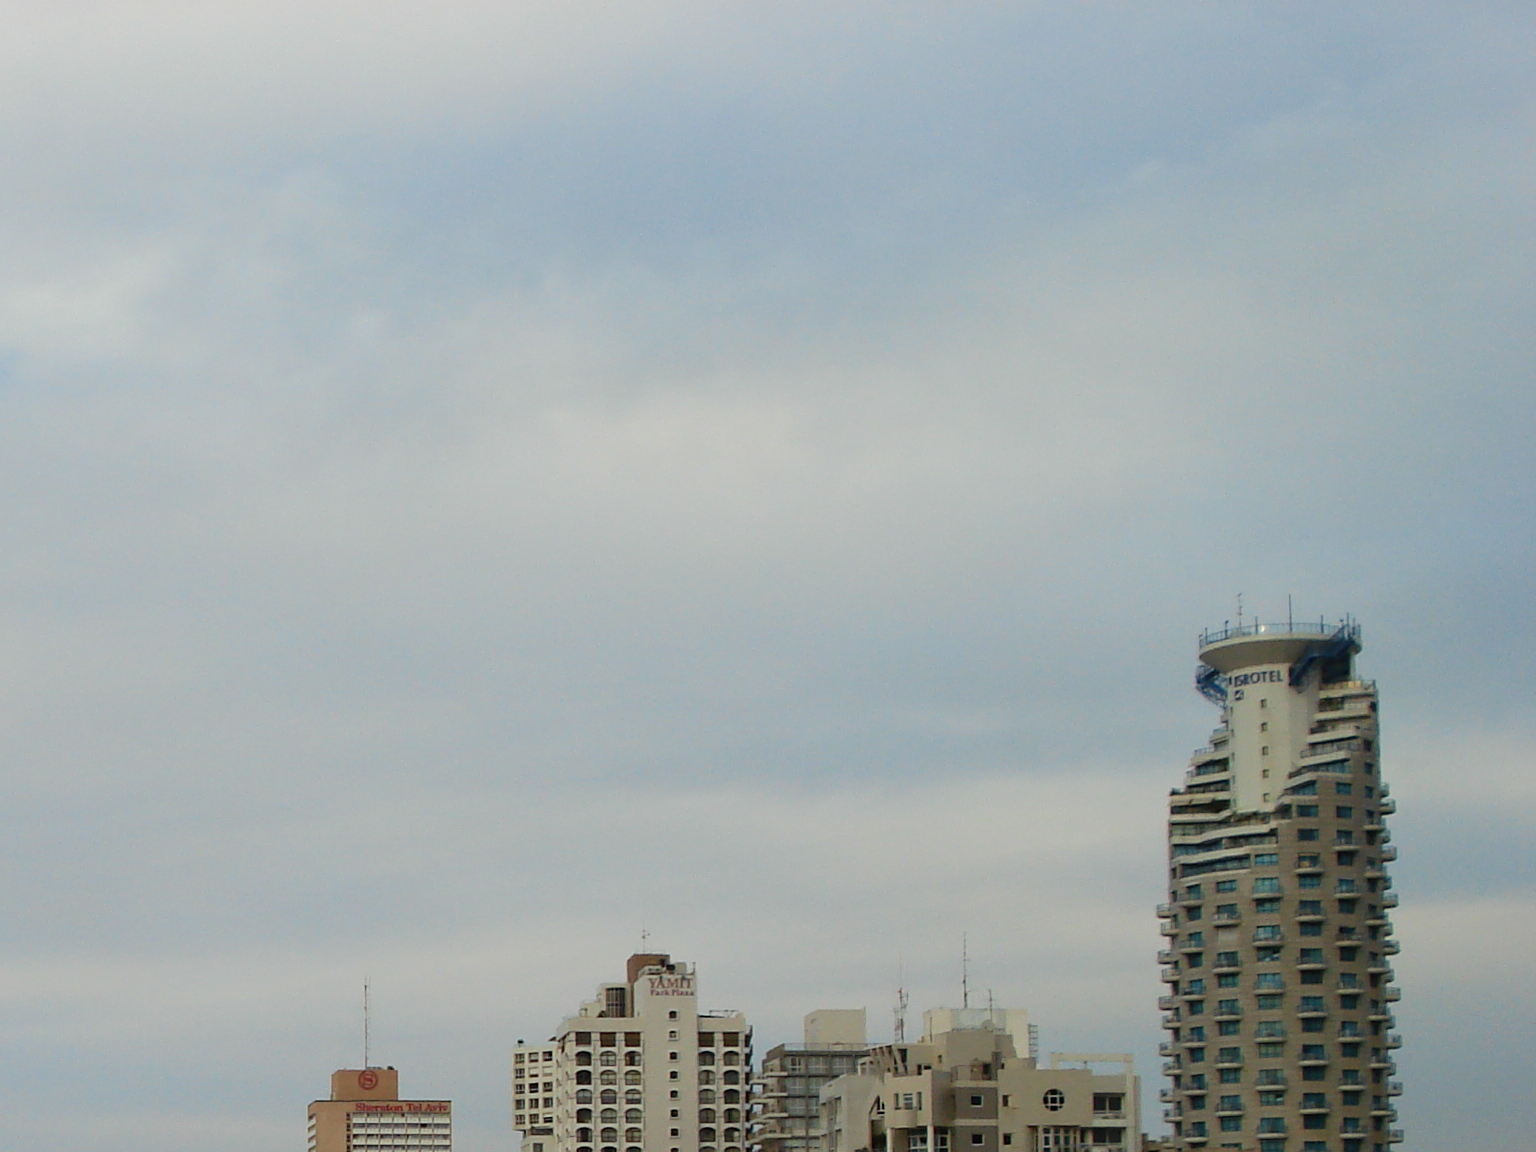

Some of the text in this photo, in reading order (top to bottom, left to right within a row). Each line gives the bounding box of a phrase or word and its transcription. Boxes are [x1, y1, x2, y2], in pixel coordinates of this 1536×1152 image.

[1234, 670, 1283, 687] ISROTEL
[648, 978, 693, 989] YAMIT
[355, 1102, 448, 1112] Sheraton Tel Aviv
